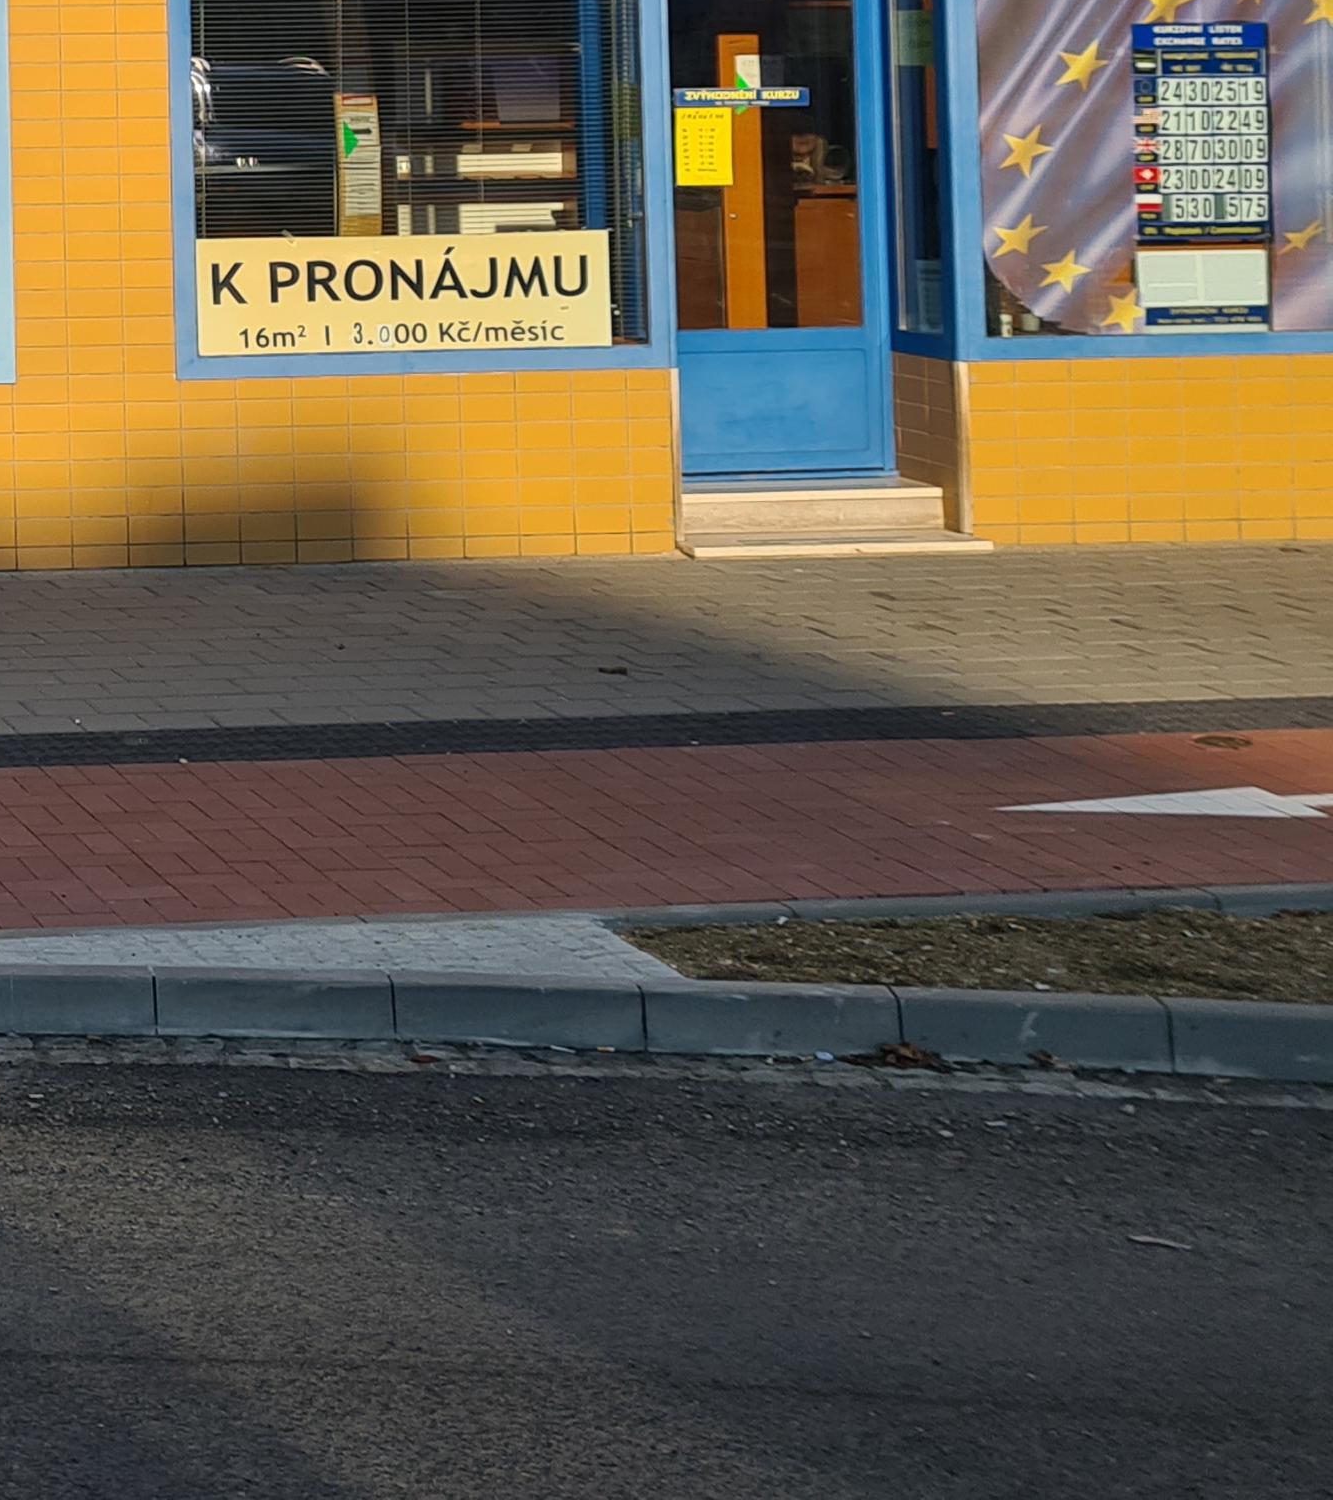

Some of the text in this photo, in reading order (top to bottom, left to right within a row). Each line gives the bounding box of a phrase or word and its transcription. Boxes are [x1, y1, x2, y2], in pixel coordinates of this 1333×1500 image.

[211, 247, 589, 305] K PRONÁJMU
[353, 322, 428, 345] 3.000
[439, 319, 565, 344] Kč/měsíc
